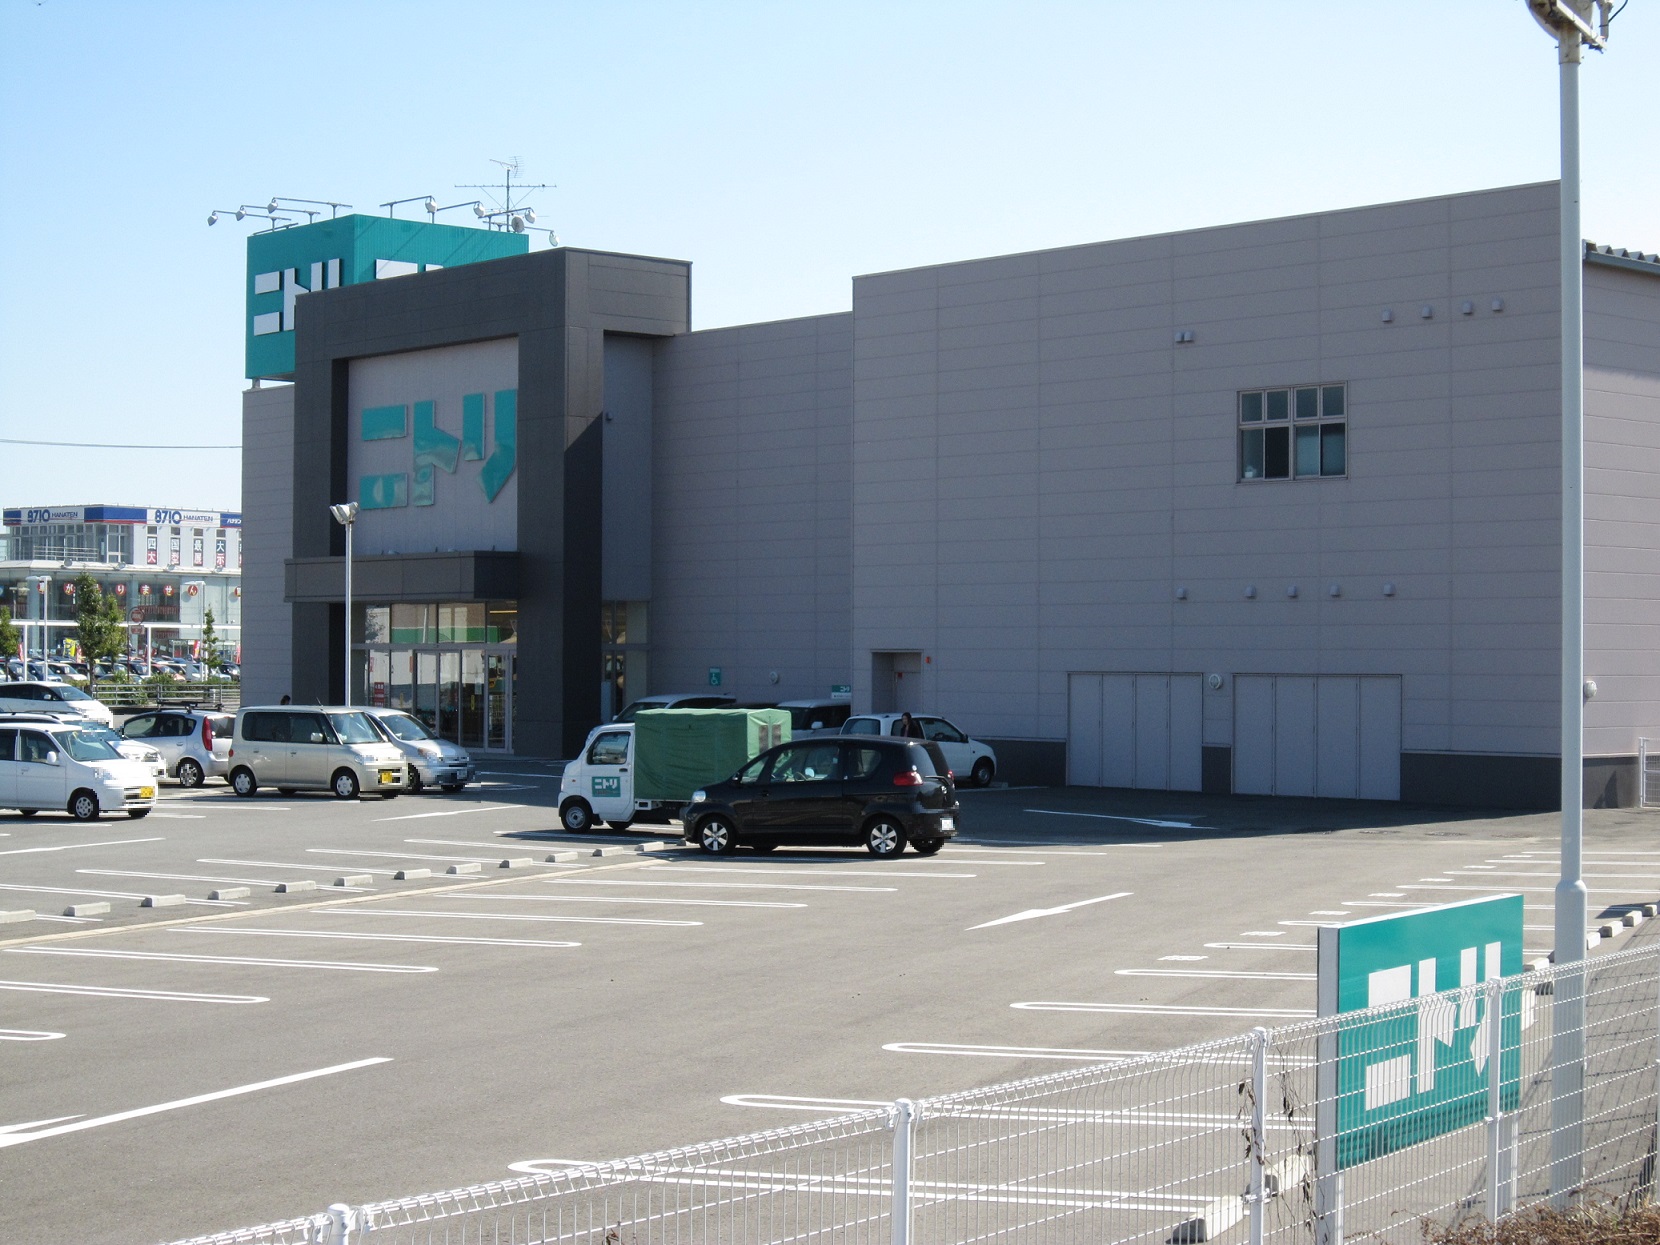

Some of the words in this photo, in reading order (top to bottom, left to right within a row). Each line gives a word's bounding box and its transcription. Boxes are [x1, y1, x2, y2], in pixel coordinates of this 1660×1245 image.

[360, 388, 517, 510] ニトリ
[27, 509, 50, 523] 8710
[154, 509, 182, 525] 8710
[183, 514, 213, 522] HANATEN
[594, 778, 618, 789] ニトリ
[1365, 941, 1501, 1111] ニトリ
